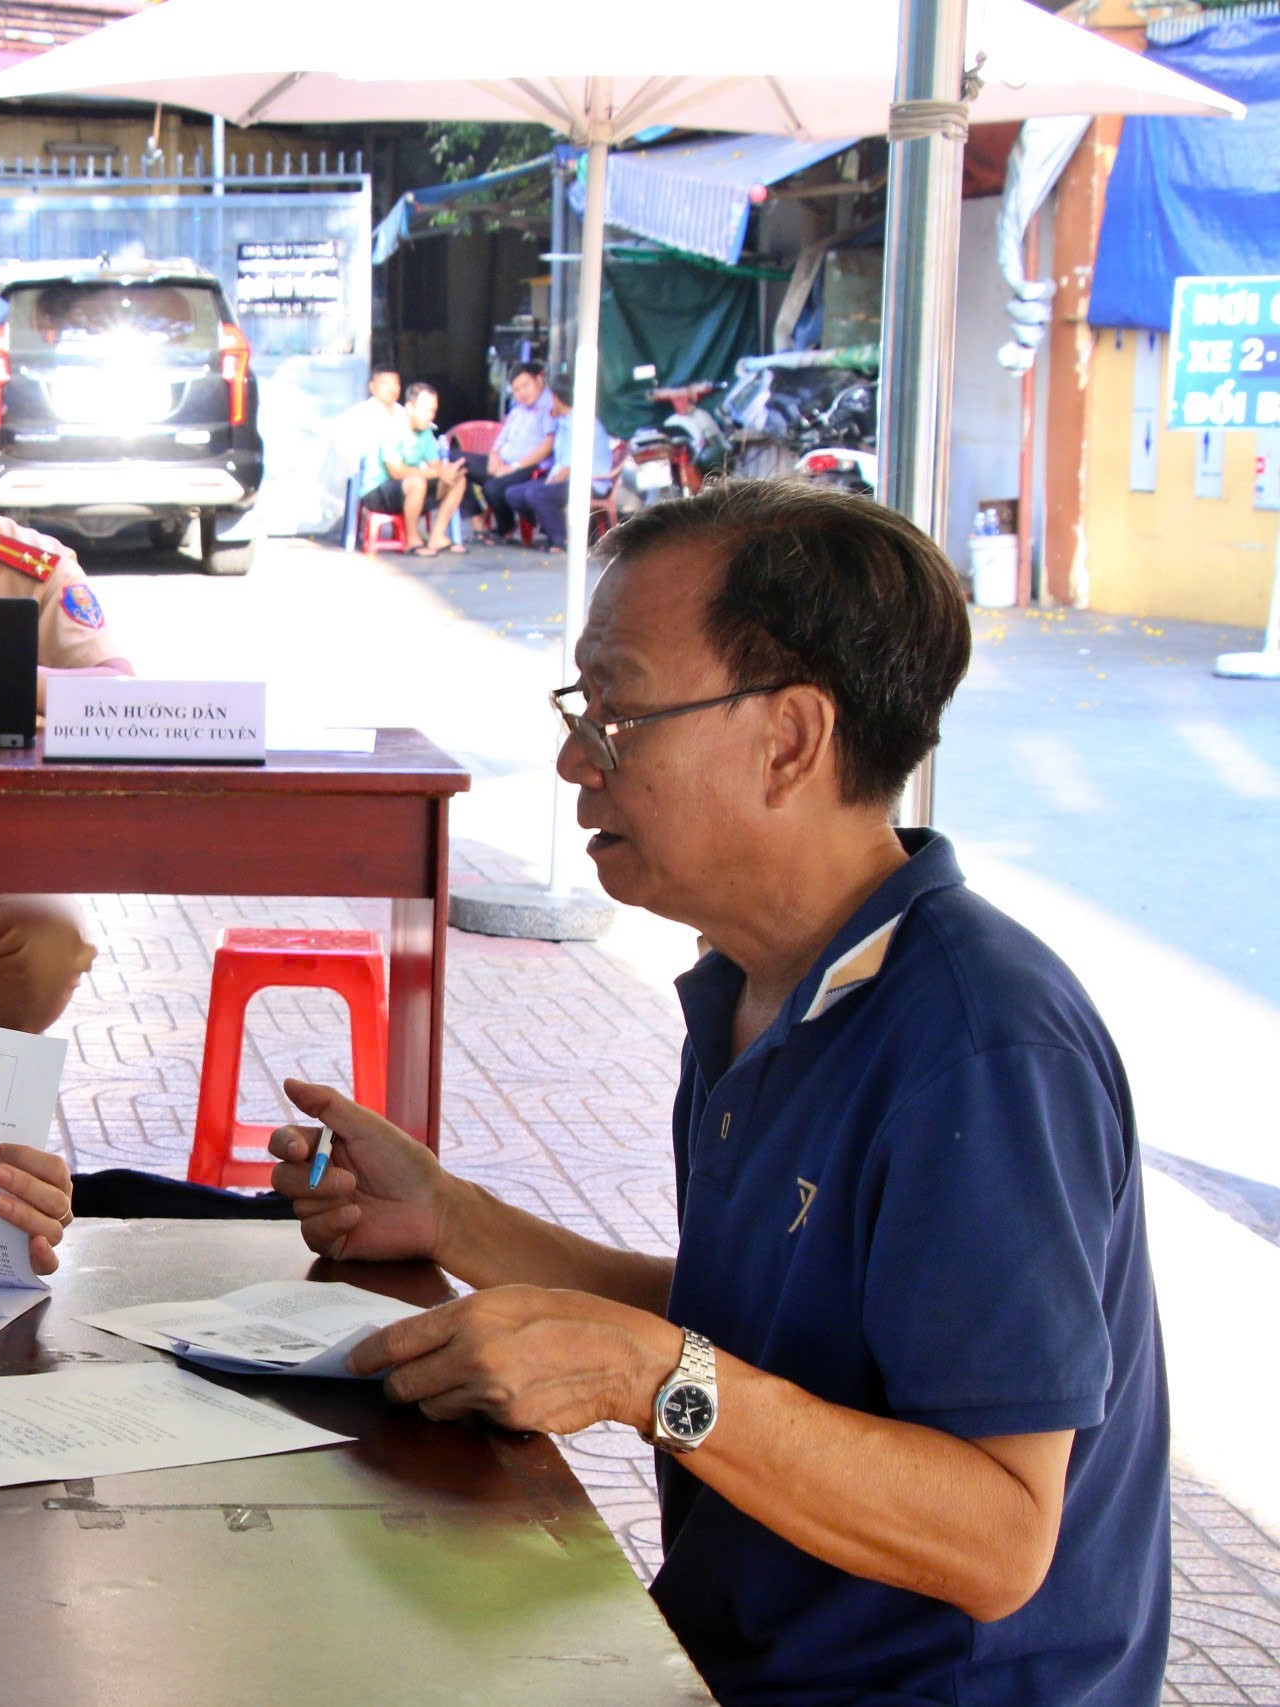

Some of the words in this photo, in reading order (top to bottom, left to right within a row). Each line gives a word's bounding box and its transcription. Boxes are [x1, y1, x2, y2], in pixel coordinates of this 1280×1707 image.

[1192, 290, 1260, 325] NƠI
[1187, 340, 1232, 373] XE
[124, 702, 186, 719] HƯỚNG
[192, 703, 226, 720] DẪN
[54, 725, 89, 739] DỊCH
[94, 727, 113, 740] VỤ
[117, 724, 159, 738] CÔNG
[164, 727, 202, 741] TRỰC
[208, 724, 257, 740] TUYẾN
